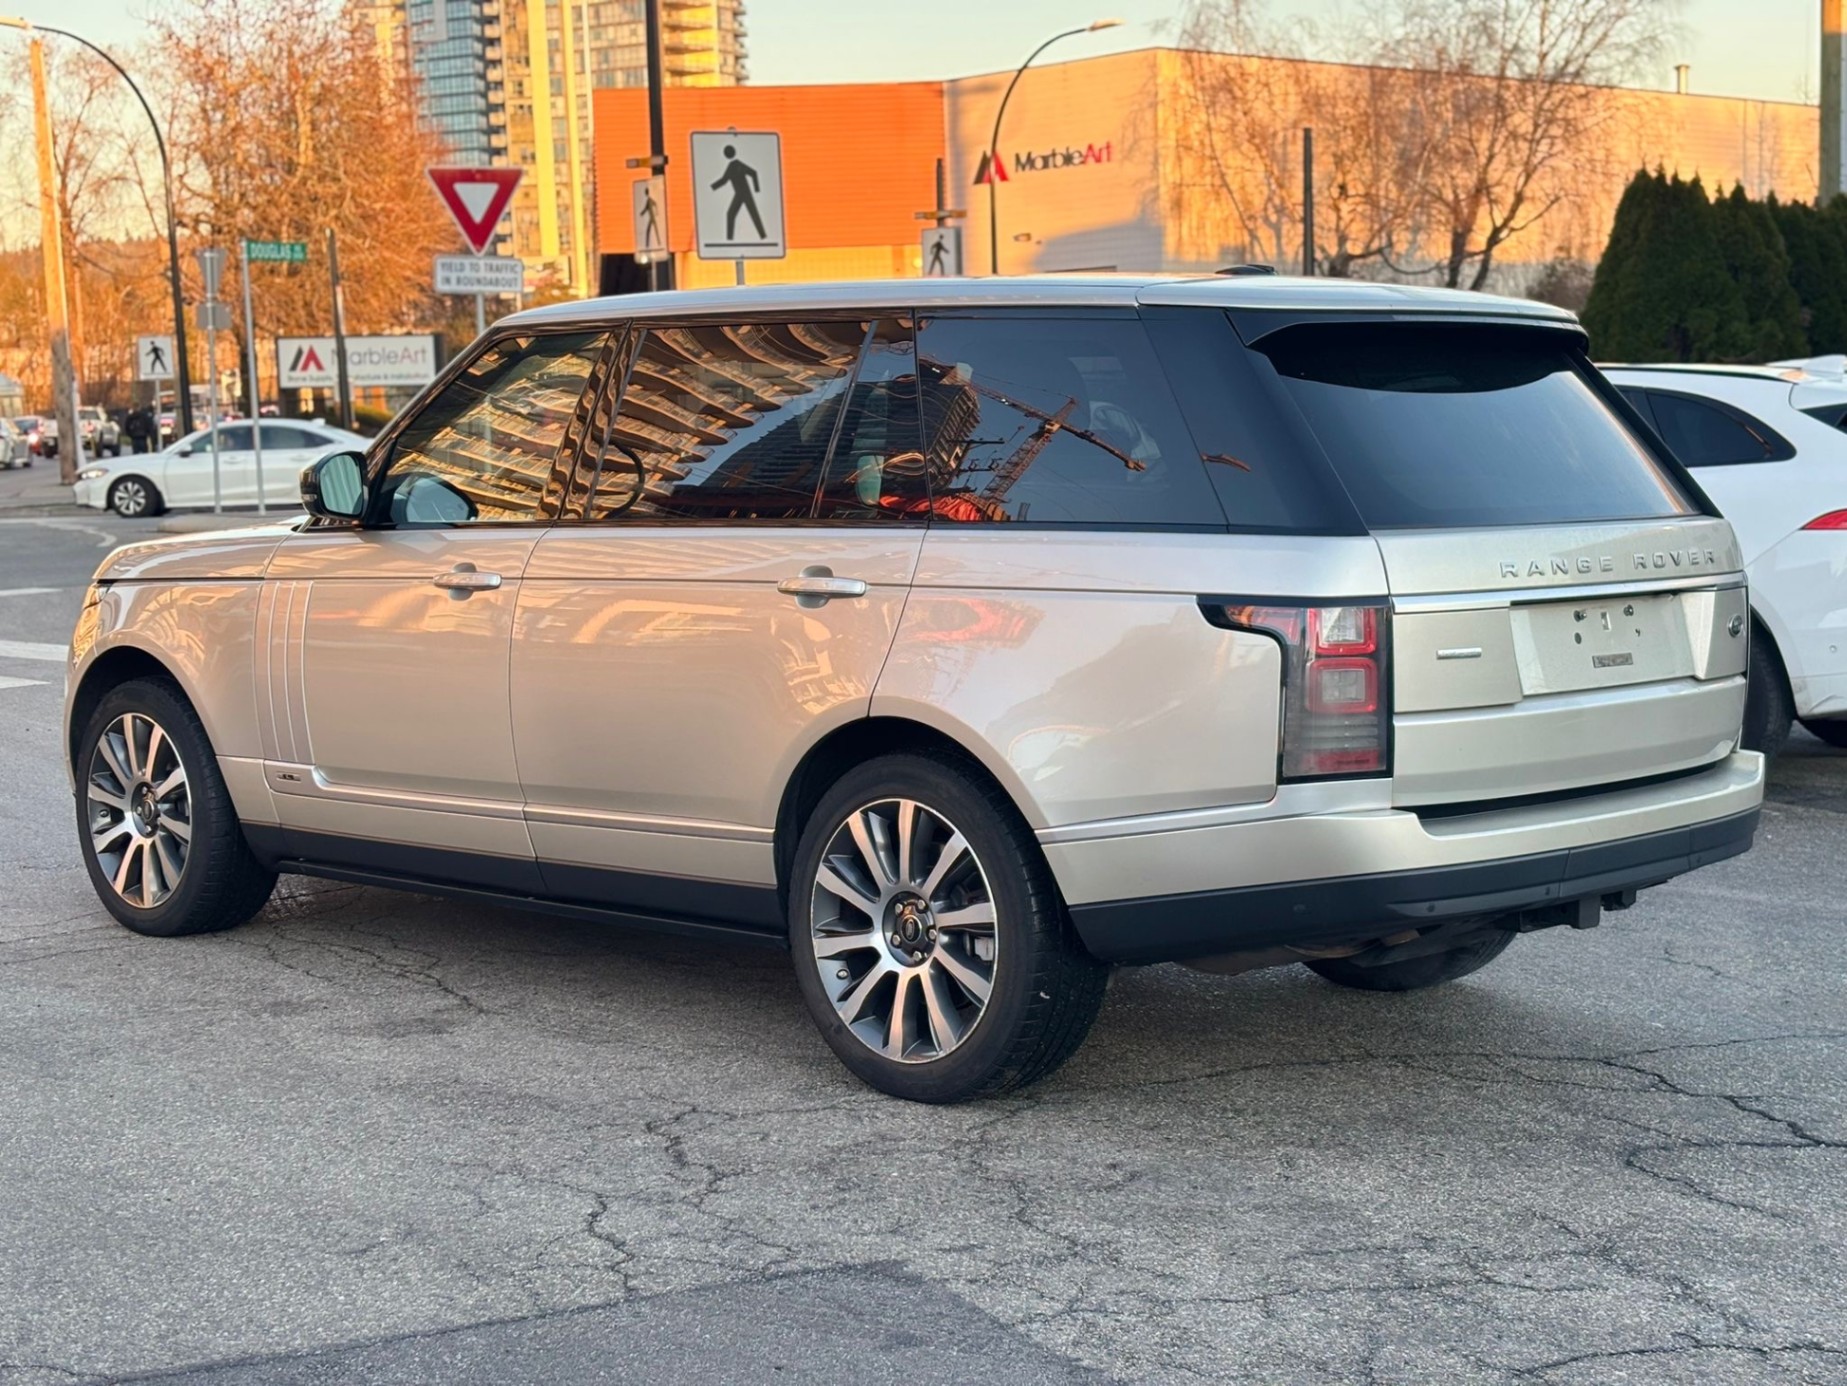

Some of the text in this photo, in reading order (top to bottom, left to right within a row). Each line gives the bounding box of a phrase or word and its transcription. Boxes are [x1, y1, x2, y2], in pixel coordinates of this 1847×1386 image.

[1015, 142, 1112, 172] MarbleArt
[250, 242, 291, 258] DOUGLAS
[441, 262, 518, 274] YIELD TO TRAFFIC
[441, 276, 518, 287] IN ROUNDABOUT
[1500, 550, 1715, 578] RANGE ROVER
